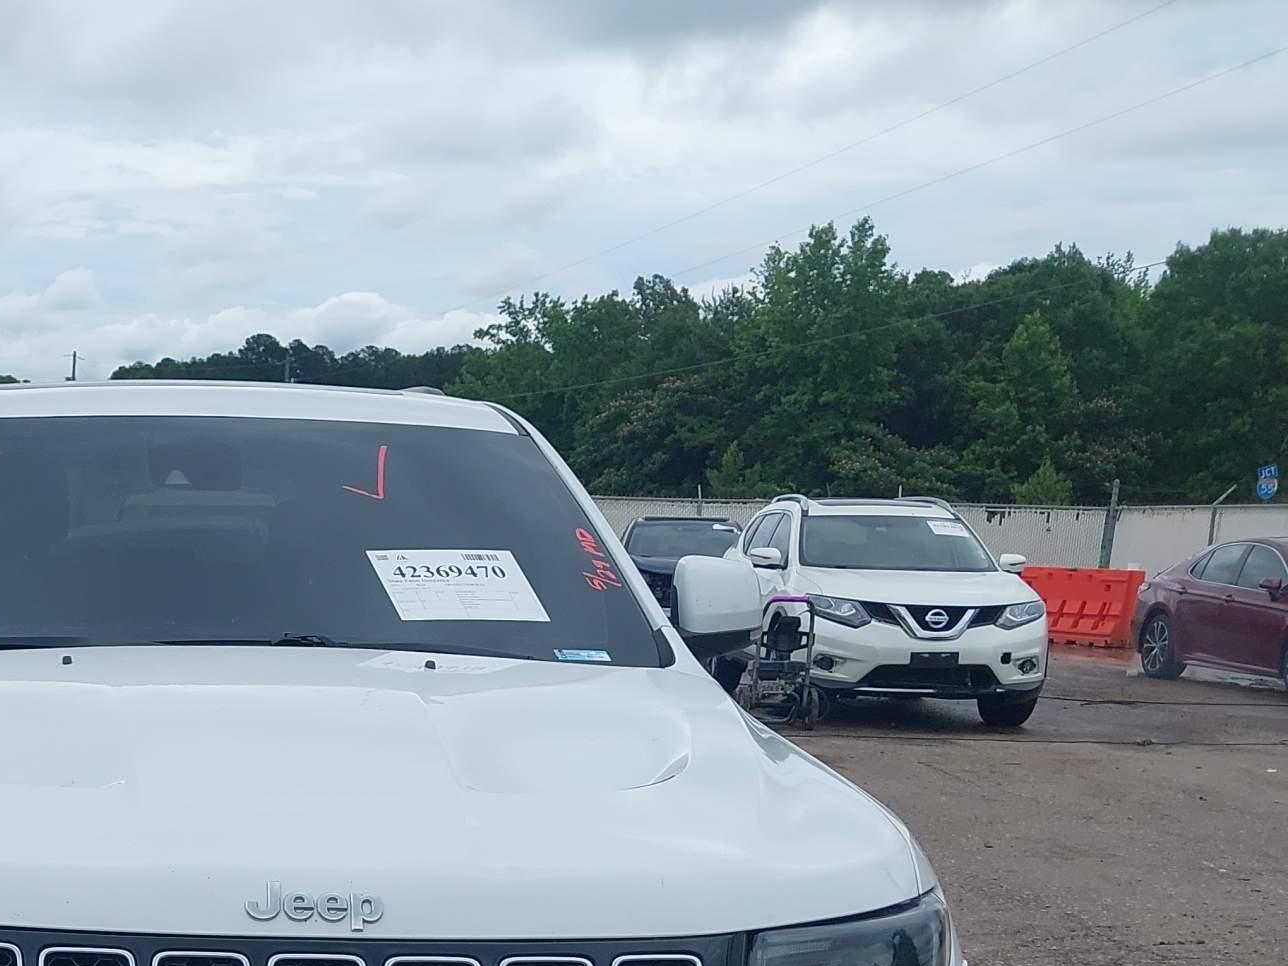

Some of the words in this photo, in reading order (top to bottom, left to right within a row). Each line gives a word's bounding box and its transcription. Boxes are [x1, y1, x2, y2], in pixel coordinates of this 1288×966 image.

[1260, 466, 1276, 478] JCT
[392, 564, 507, 579] 42369470
[244, 880, 384, 932] Jeep
